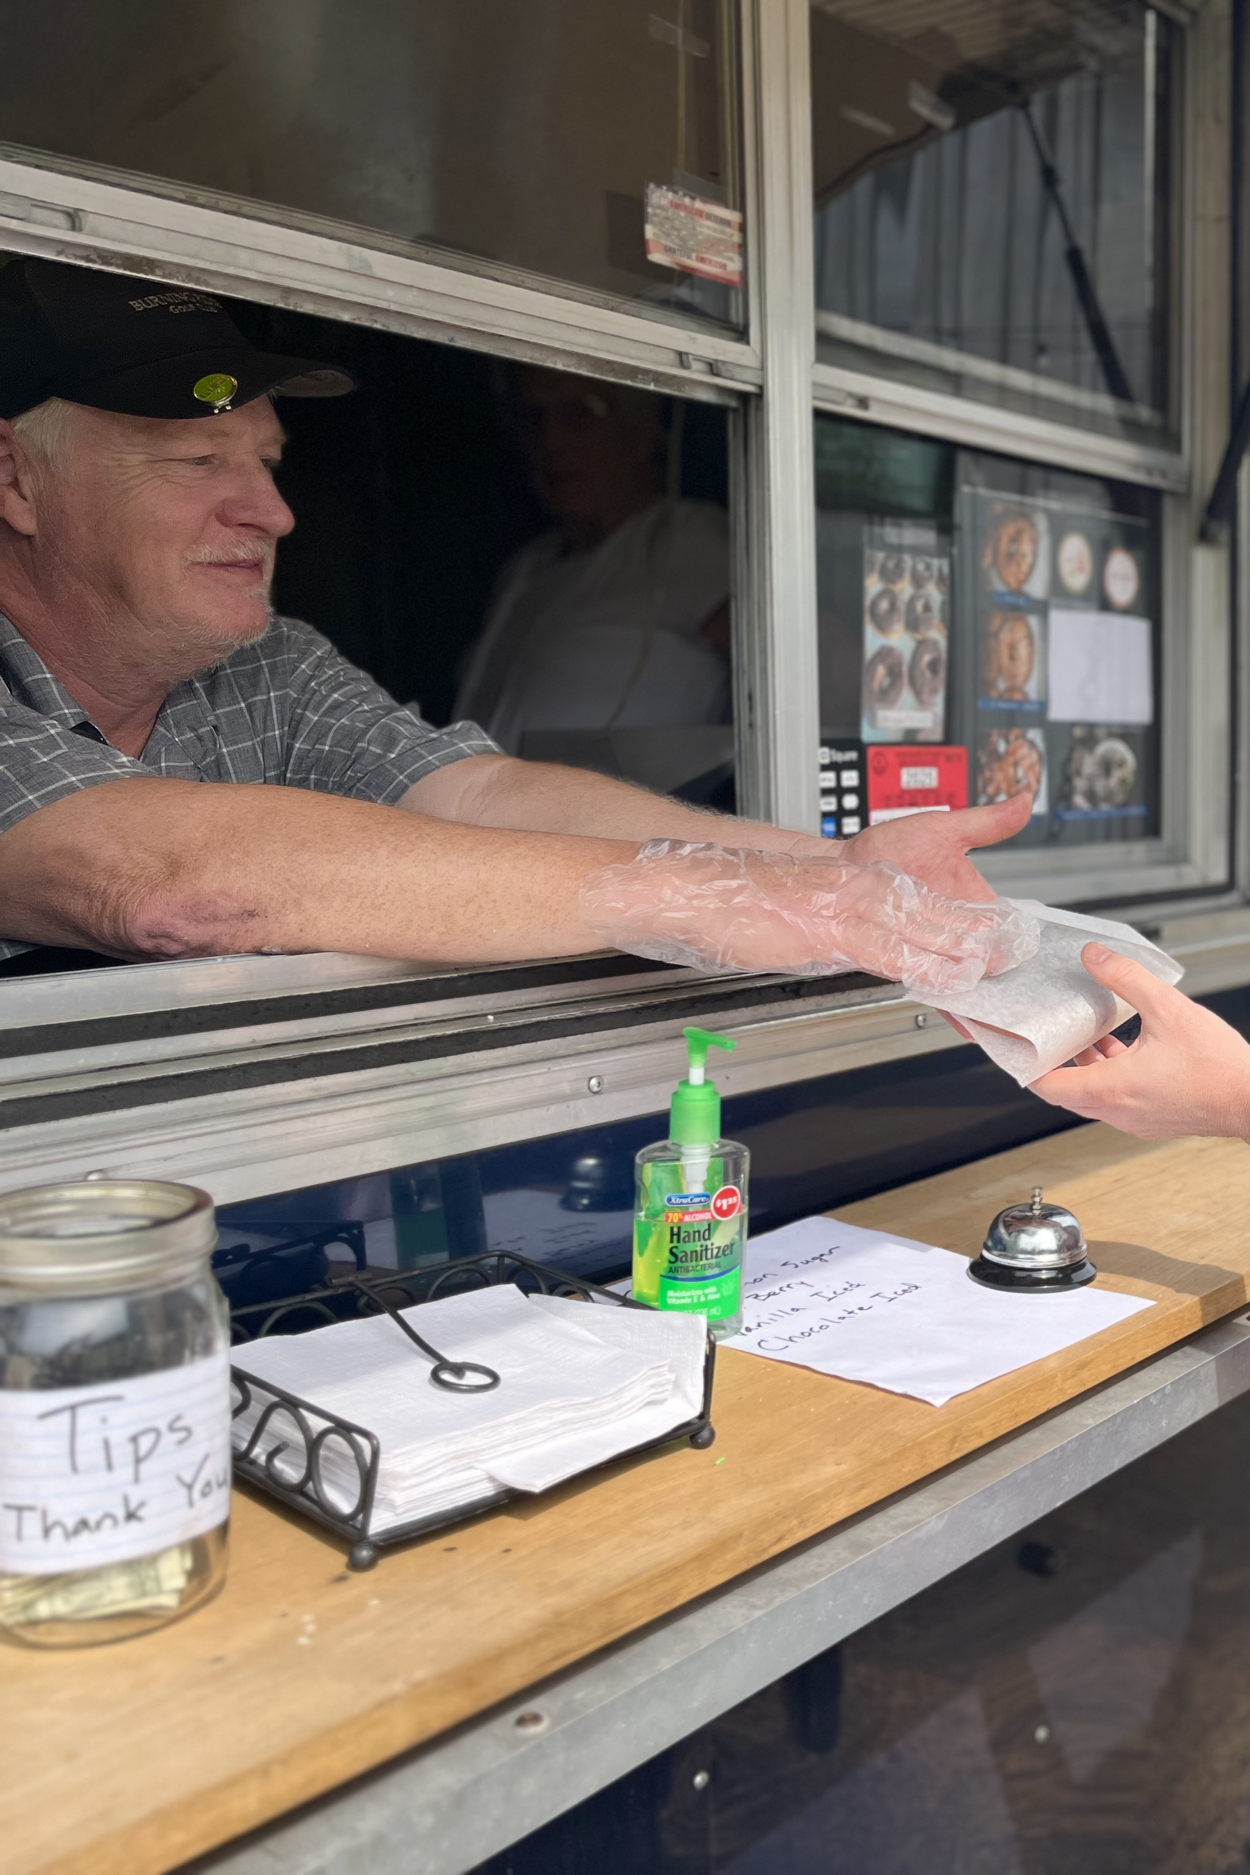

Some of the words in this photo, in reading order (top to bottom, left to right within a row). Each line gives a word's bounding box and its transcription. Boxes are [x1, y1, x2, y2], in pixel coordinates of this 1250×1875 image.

[670, 200, 704, 219] AMERICAN
[683, 1212, 712, 1222] ALCOHOL
[669, 1223, 711, 1244] Hand
[668, 1242, 735, 1264] Sanitizer
[780, 1245, 841, 1269] Sugar
[668, 1262, 722, 1274] ANTIBACTERIAL
[745, 1280, 815, 1302] Berry
[809, 1280, 866, 1302] Iced
[756, 1305, 874, 1352] Chocolate
[869, 1281, 922, 1303] Iced
[36, 1394, 194, 1484] Tips
[2, 1492, 147, 1543] Thank
[175, 1452, 230, 1510] You
